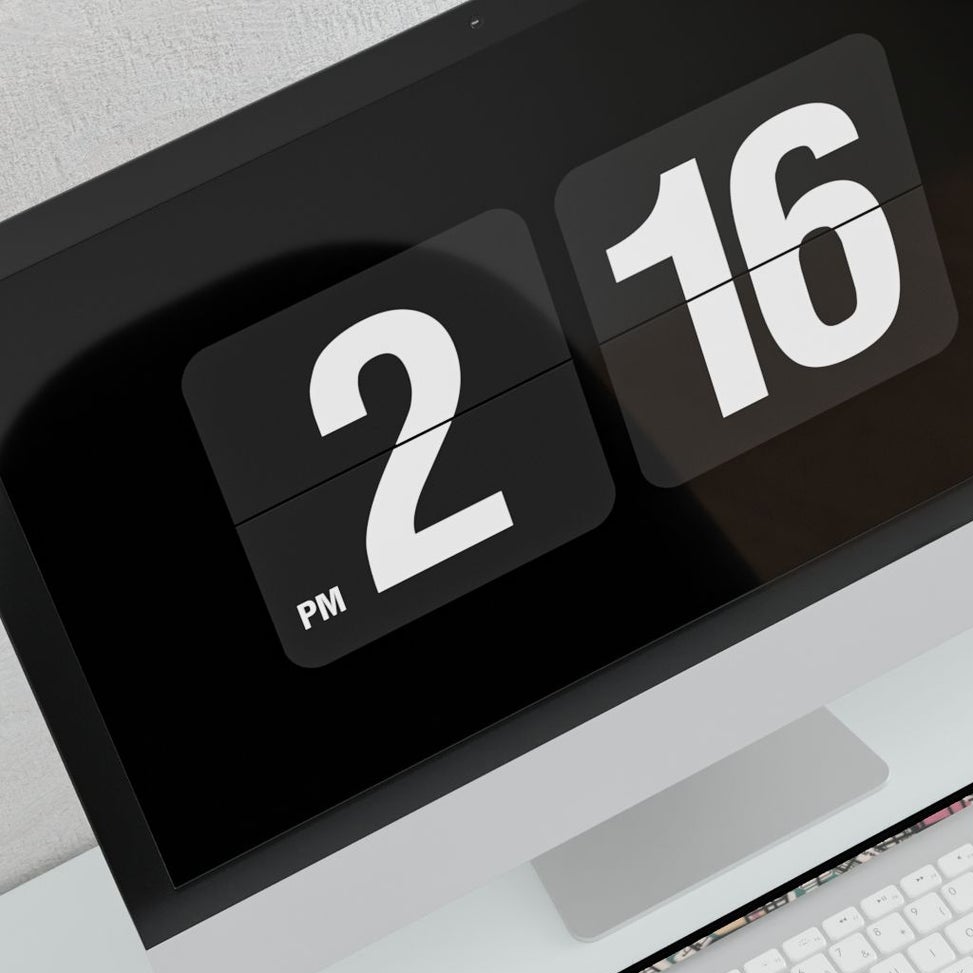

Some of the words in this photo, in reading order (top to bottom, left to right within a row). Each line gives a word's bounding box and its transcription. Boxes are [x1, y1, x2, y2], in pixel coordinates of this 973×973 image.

[309, 308, 514, 593] 2
[605, 101, 901, 418] 16
[296, 585, 347, 631] PM
